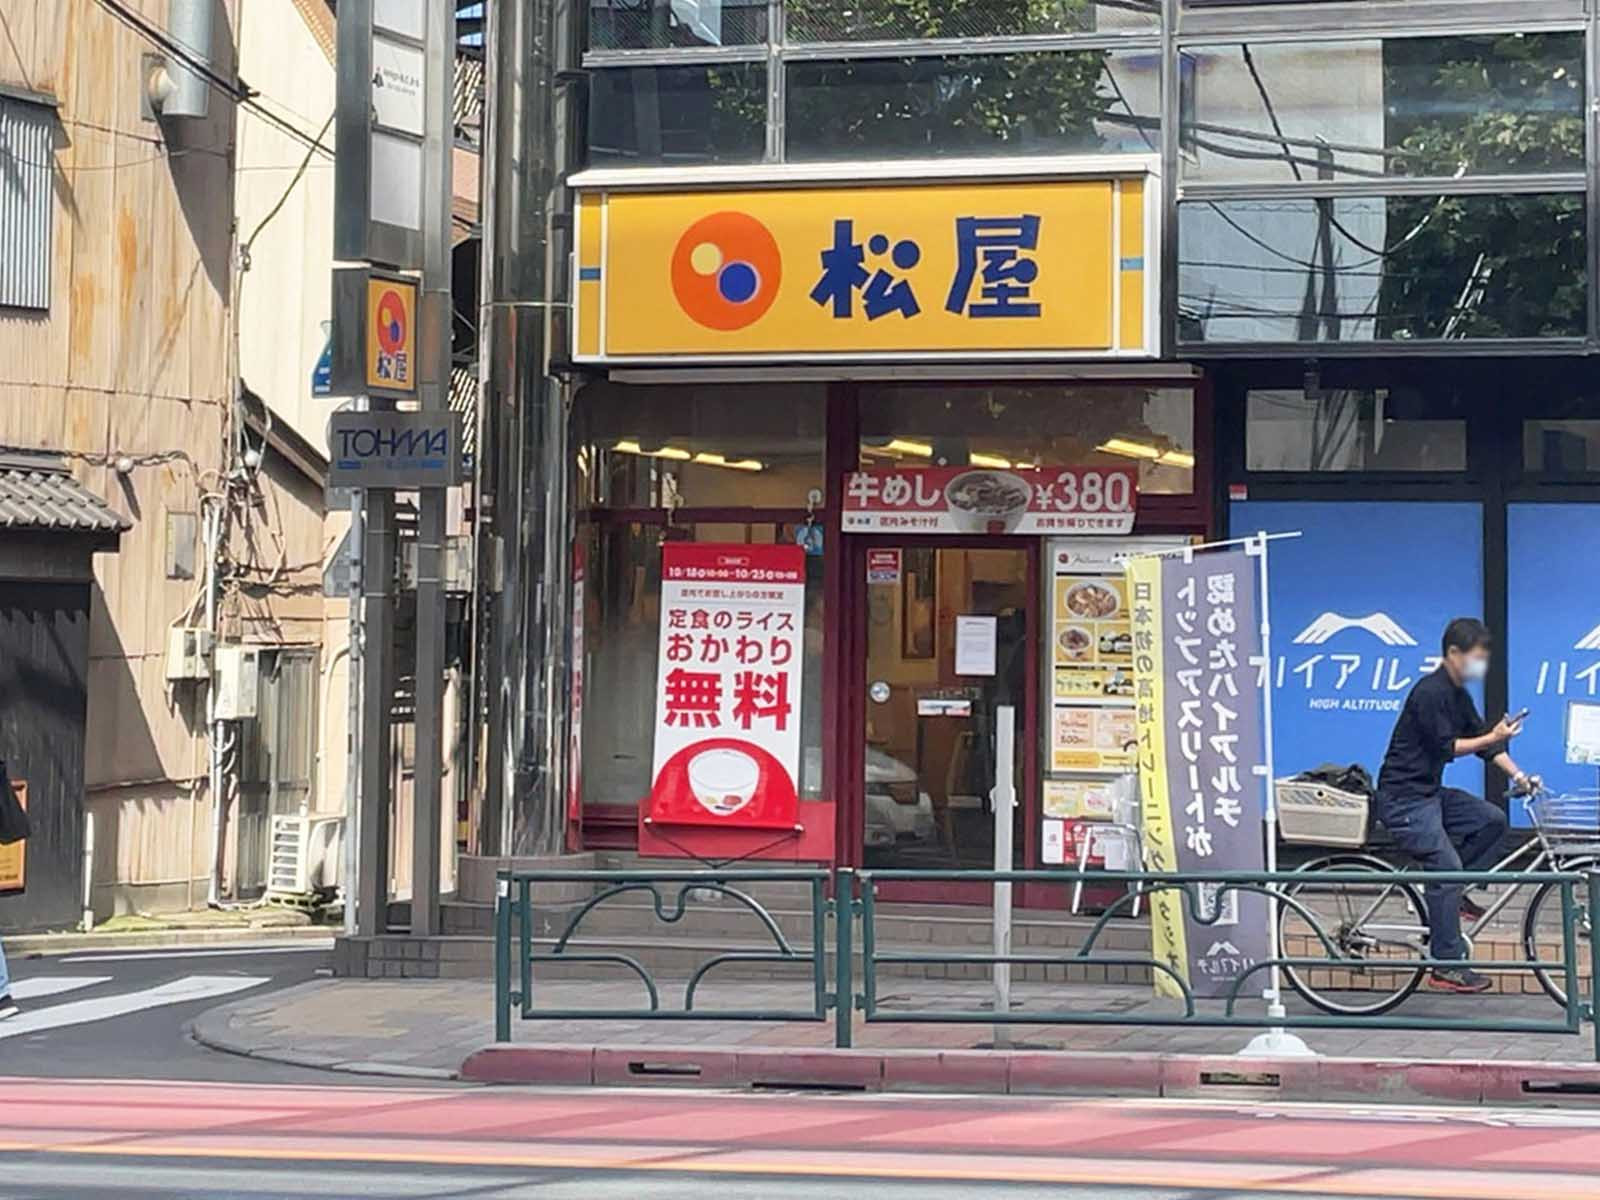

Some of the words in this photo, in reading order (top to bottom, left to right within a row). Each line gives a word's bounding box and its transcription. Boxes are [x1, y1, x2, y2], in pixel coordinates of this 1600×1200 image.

[809, 214, 1042, 321] 松屋
[378, 350, 408, 382] 松屋
[338, 428, 448, 457] TOHMA
[848, 472, 942, 508] 牛めし
[668, 609, 795, 631] 定食のライス
[666, 633, 793, 665] おかわり
[664, 667, 793, 731] 無料
[1309, 698, 1339, 711] HIGH
[1342, 698, 1401, 711] ALTITUDE
